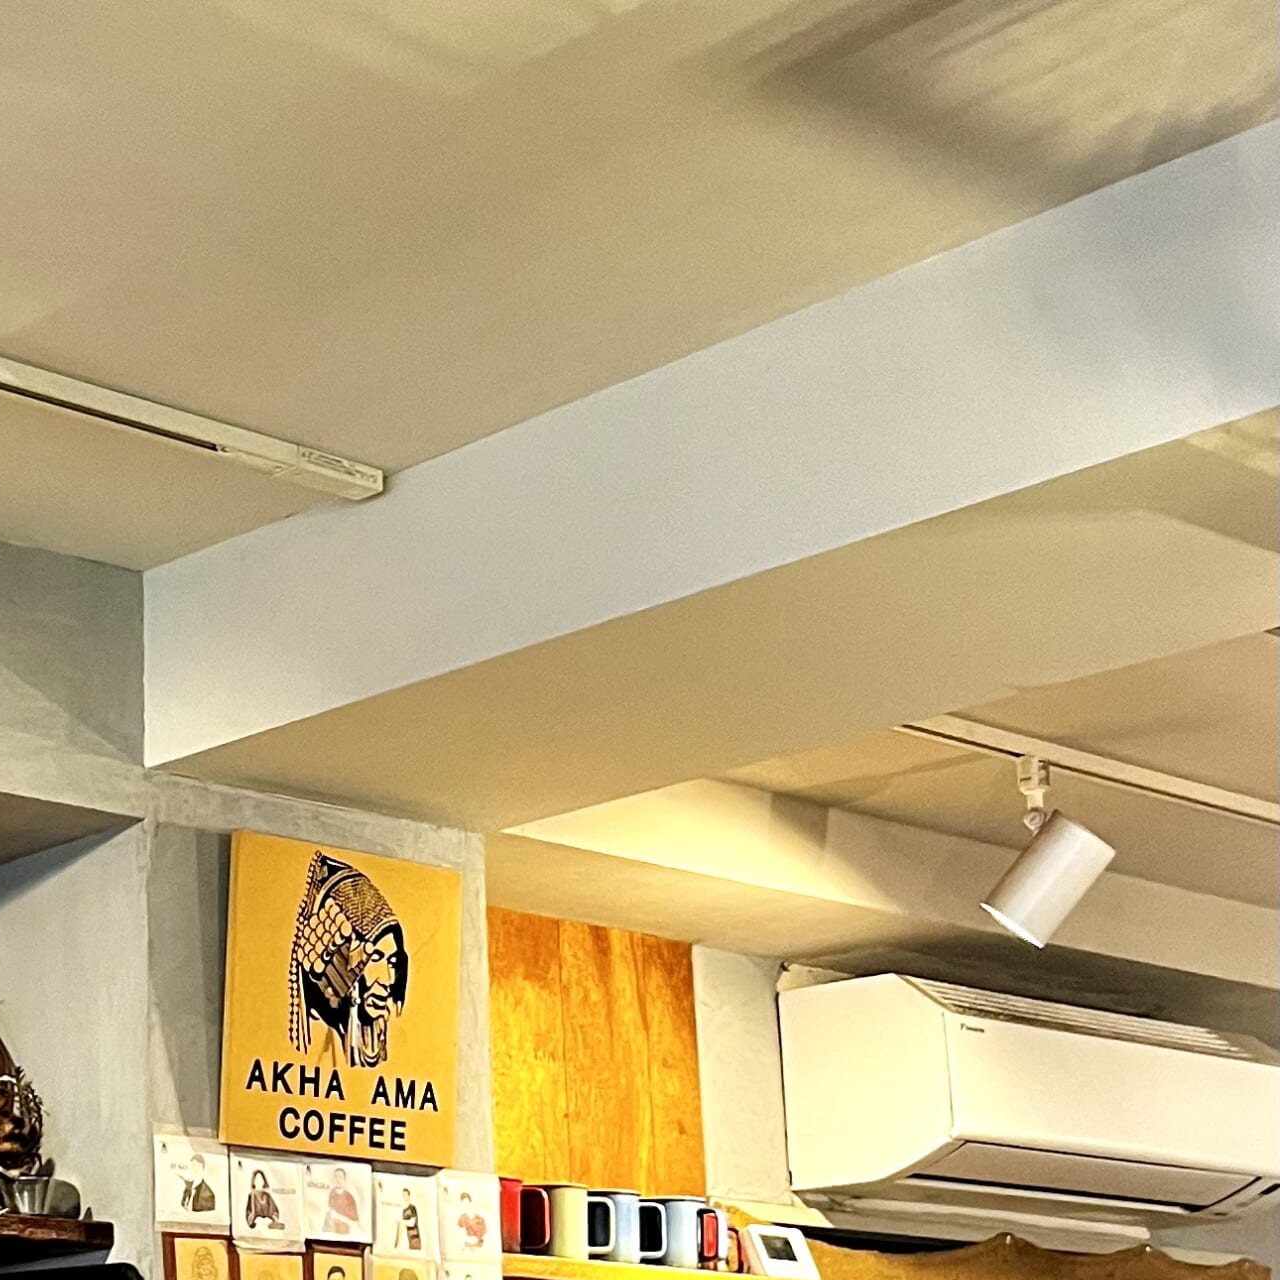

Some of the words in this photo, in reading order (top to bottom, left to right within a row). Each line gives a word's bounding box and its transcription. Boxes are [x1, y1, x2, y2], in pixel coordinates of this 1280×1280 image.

[246, 1058, 345, 1101] AKHA
[370, 1075, 439, 1112] AMA
[279, 1106, 407, 1151] COFFEE
